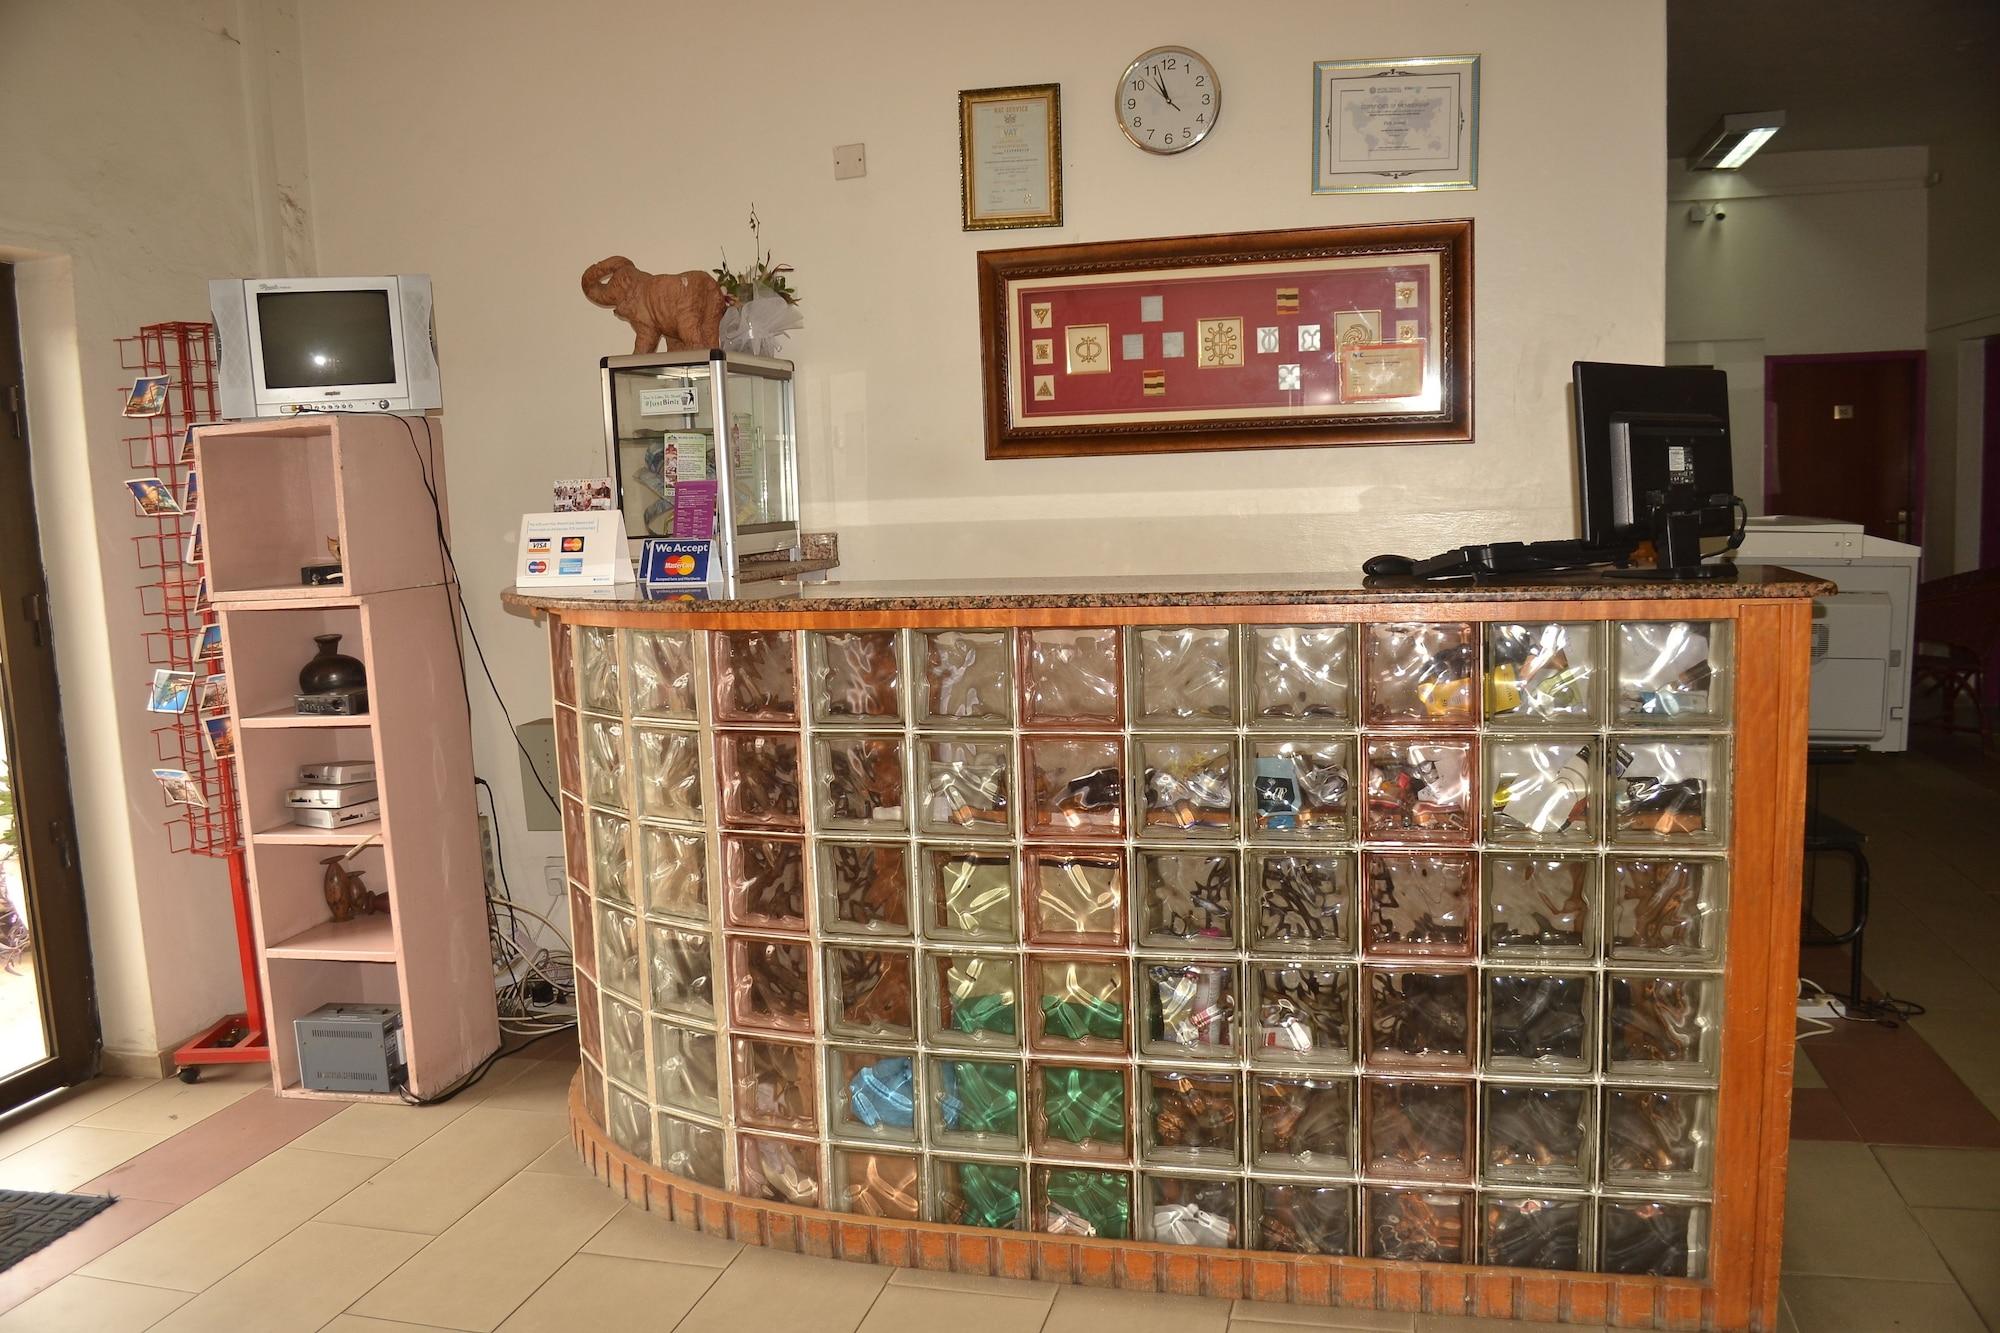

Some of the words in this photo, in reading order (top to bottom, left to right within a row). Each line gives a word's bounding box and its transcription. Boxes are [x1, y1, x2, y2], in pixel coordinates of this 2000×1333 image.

[1161, 59, 1175, 70] 12
[1184, 63, 1190, 74] 1
[1145, 65, 1158, 76] 11
[1132, 80, 1145, 91] 10
[1195, 76, 1204, 87] 2
[1127, 99, 1136, 109] 9
[1201, 94, 1210, 105] 3
[1133, 117, 1141, 127] 8
[1195, 113, 1204, 123] 4
[1146, 129, 1155, 140] 7
[1182, 127, 1191, 138] 5
[1164, 133, 1173, 144] 6
[655, 544, 672, 553] We
[673, 543, 708, 554] Accept
